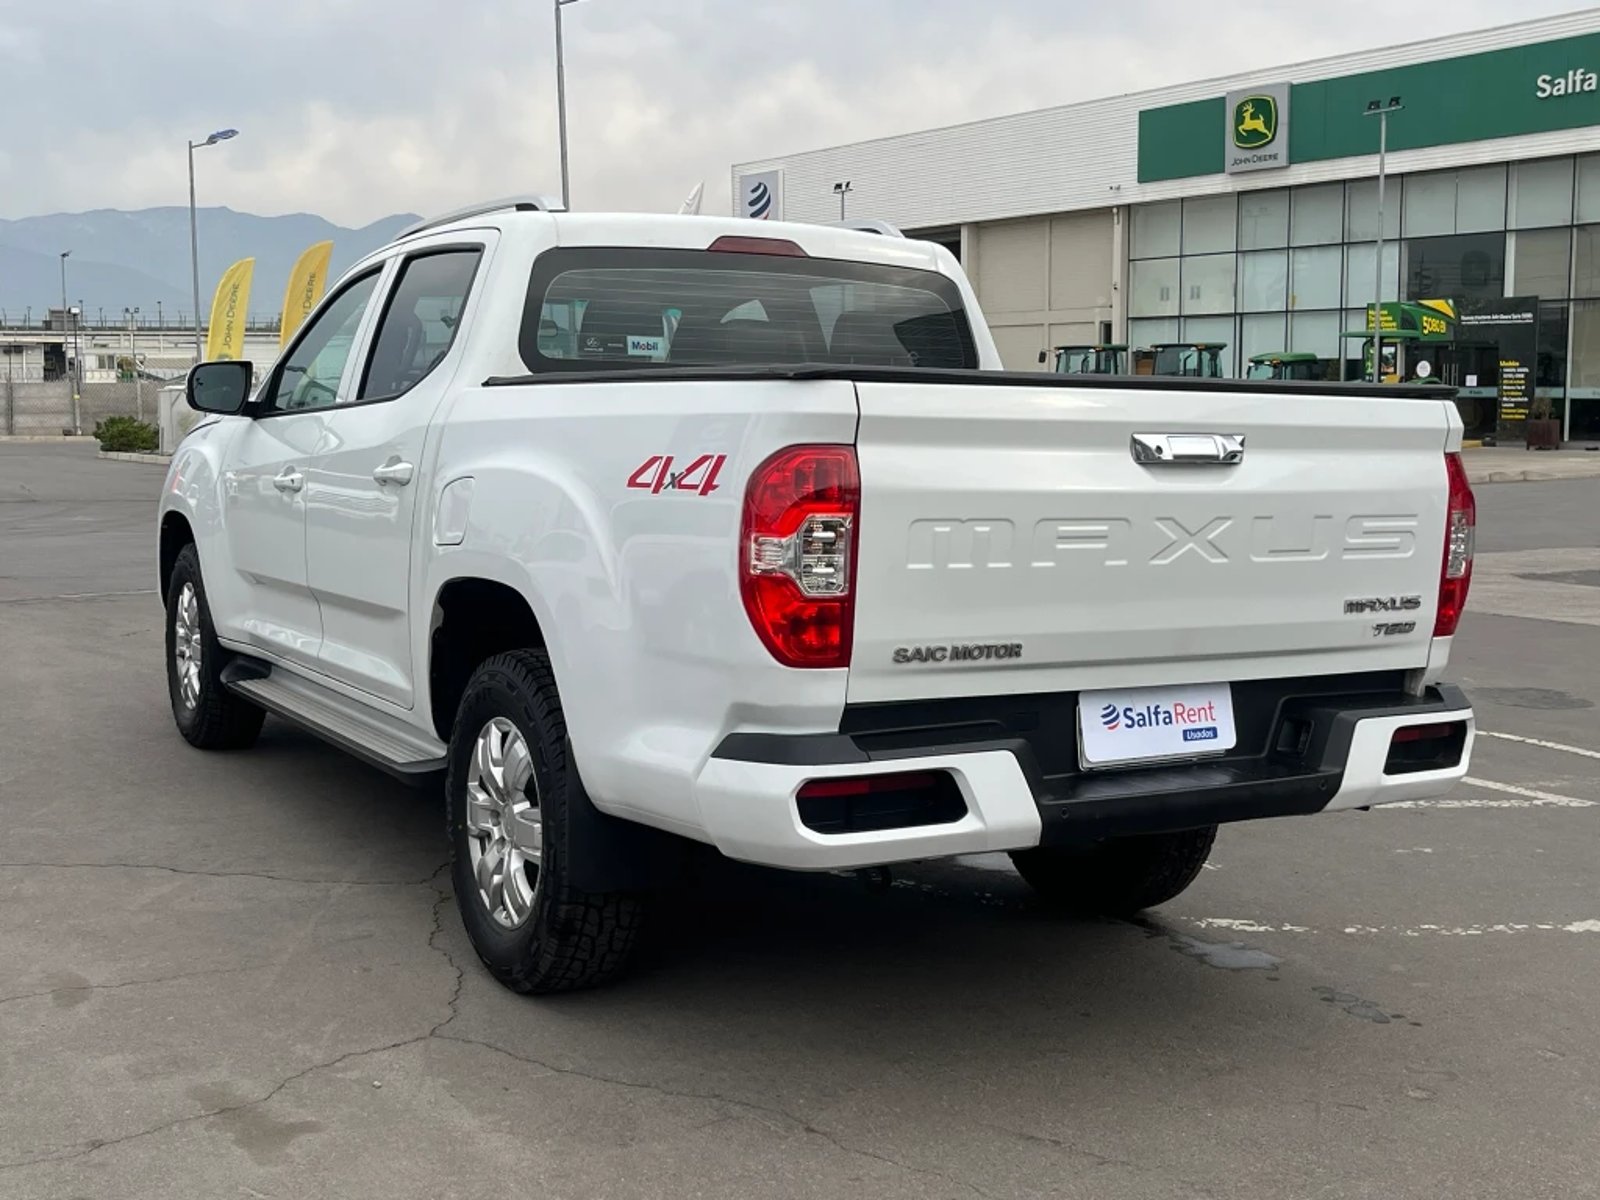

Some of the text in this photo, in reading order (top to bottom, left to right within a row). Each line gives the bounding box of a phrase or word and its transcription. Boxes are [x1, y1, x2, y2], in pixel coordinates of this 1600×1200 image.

[1536, 68, 1598, 98] Salfa
[1232, 153, 1279, 166] JOHN DEERE
[223, 282, 240, 349] JOHN DEERE
[632, 341, 659, 351] Mobil
[626, 454, 728, 496] 4x4
[907, 514, 1418, 569] MAXUS
[1343, 595, 1422, 615] MAXUS
[892, 643, 1023, 663] SAIC MOTOR
[1123, 701, 1217, 729] SalfaRent
[1186, 729, 1214, 740] Usados
